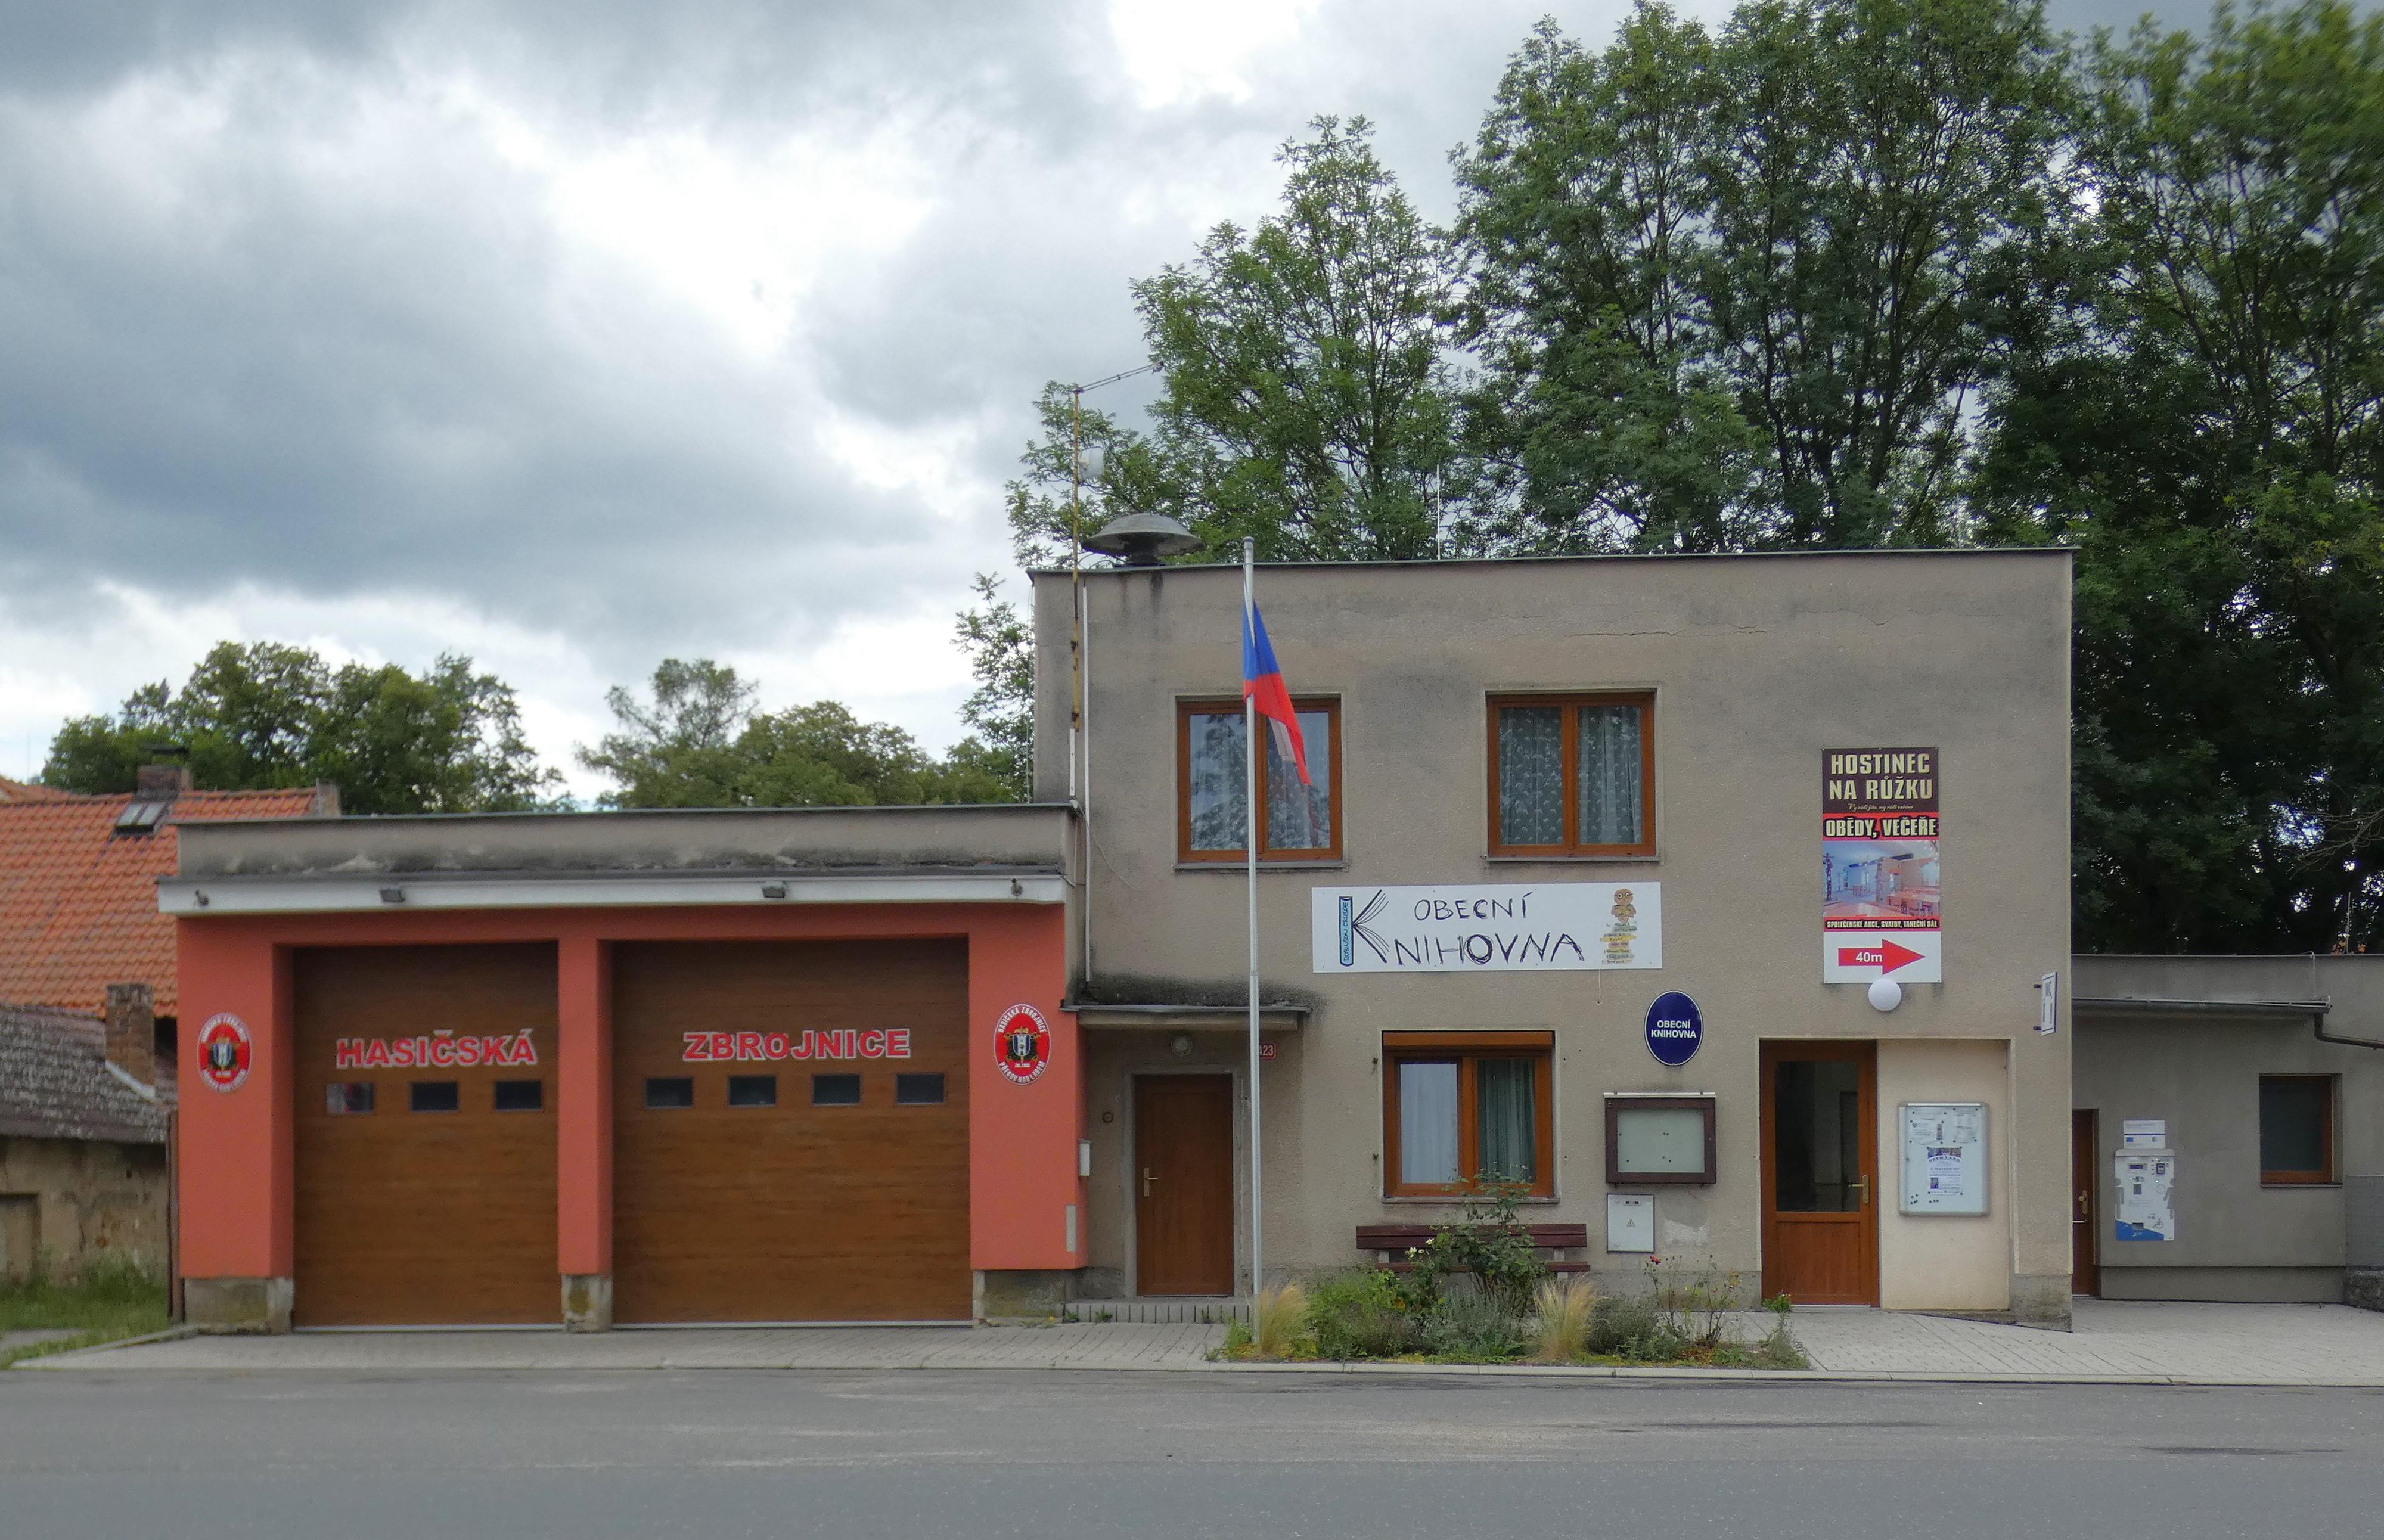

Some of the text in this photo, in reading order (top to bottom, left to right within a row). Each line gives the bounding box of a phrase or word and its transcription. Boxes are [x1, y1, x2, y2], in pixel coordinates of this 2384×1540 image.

[1831, 753, 1930, 774] HOSTINEC
[1829, 775, 1933, 800] NA RŮŽKU
[1826, 816, 1936, 839] OBĚDY, VEČEŘE
[1414, 891, 1534, 921] OBECNÍ
[1855, 952, 1882, 962] 40m
[1651, 1029, 1697, 1038] KNIHOVNA
[1657, 1019, 1691, 1028] OBECNÍ
[336, 1027, 911, 1069] HASIČSKÁ ZBROJNICE
